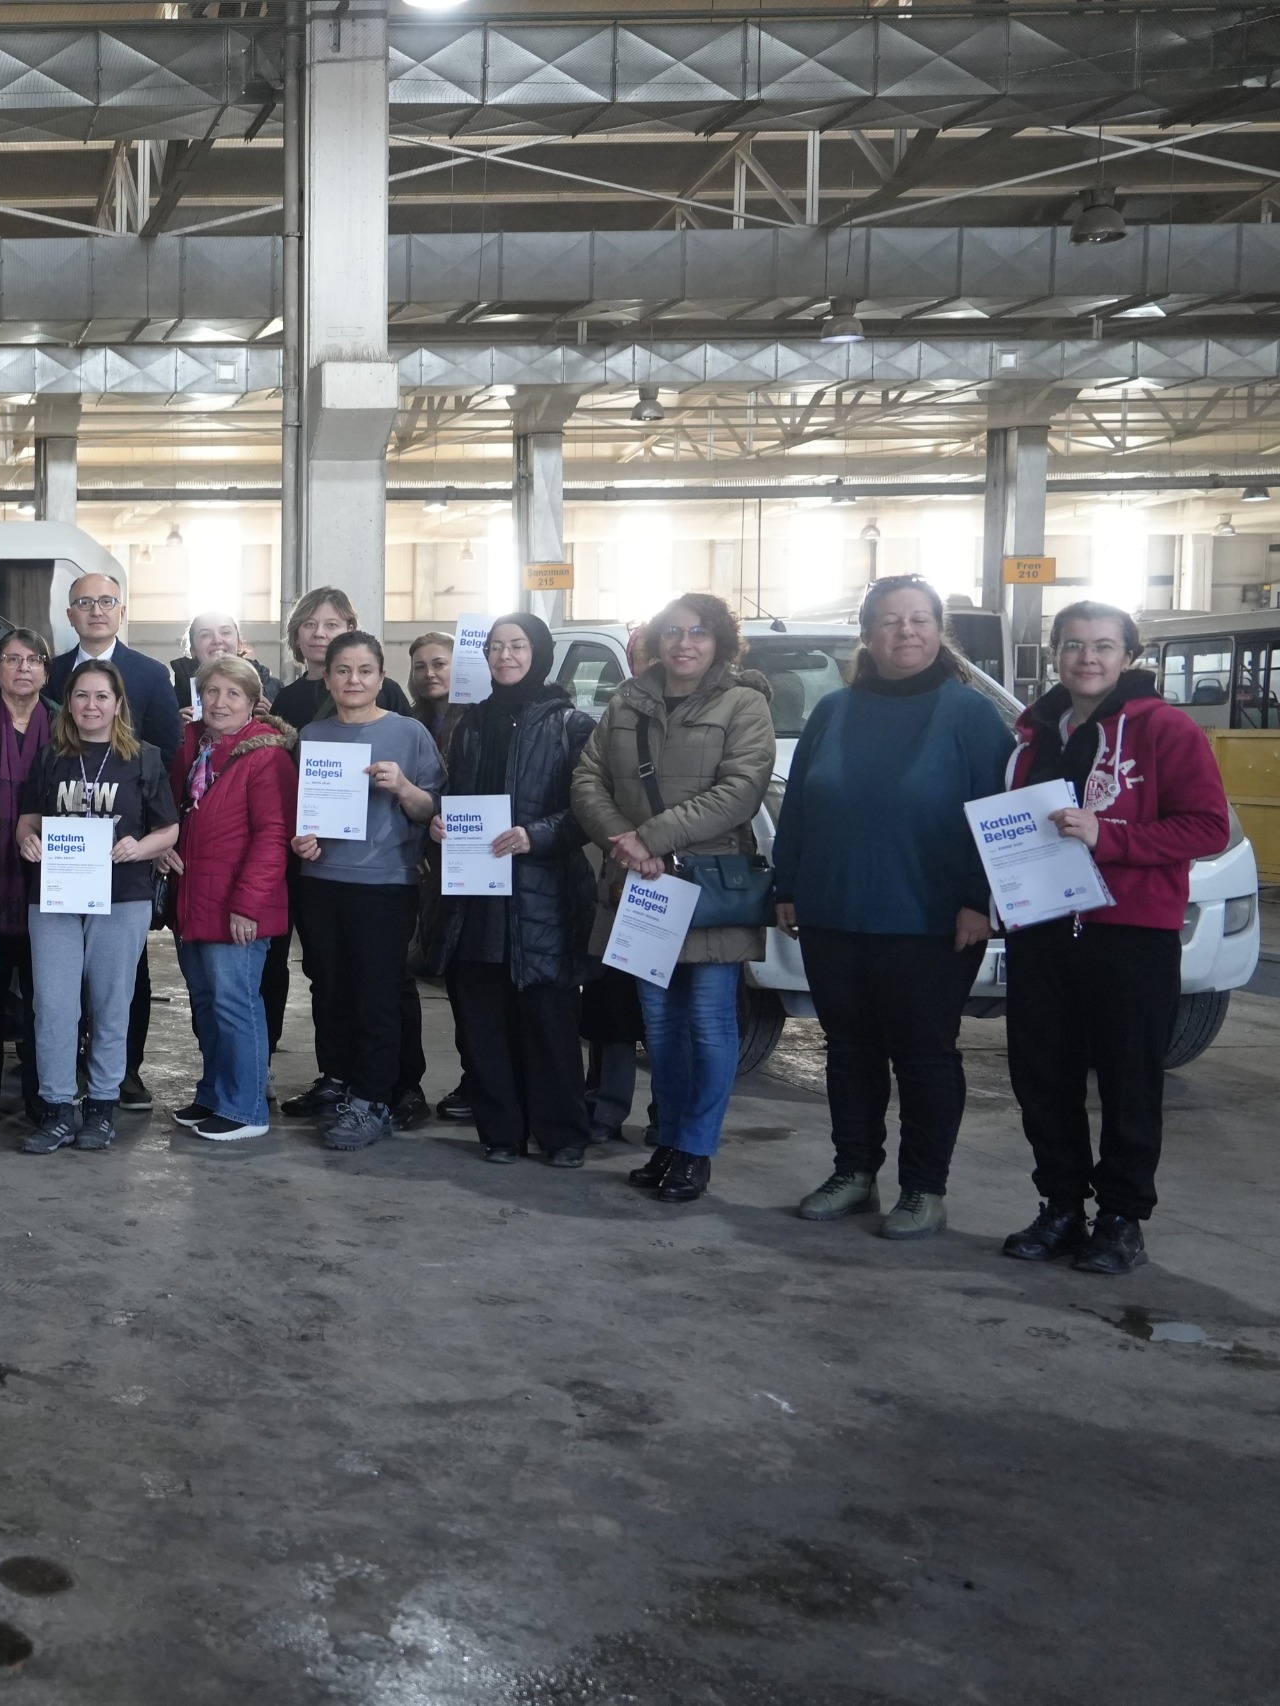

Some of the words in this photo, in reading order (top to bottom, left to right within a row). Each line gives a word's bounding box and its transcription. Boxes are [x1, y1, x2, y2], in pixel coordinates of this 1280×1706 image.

[1018, 570, 1039, 579] 210
[538, 577, 555, 586] 215
[461, 629, 488, 638] Katılı
[306, 758, 342, 768] Katılım
[305, 768, 343, 779] Belgesi
[56, 780, 119, 812] NEW
[446, 813, 482, 822] Katılım
[979, 811, 1032, 832] Katılım
[446, 822, 483, 834] Belgesi
[983, 820, 1038, 844] Belgesi
[47, 833, 84, 843] Katılım
[47, 843, 86, 854] Belgesi
[630, 883, 669, 904] Katılım
[627, 894, 668, 914] Belgesi
